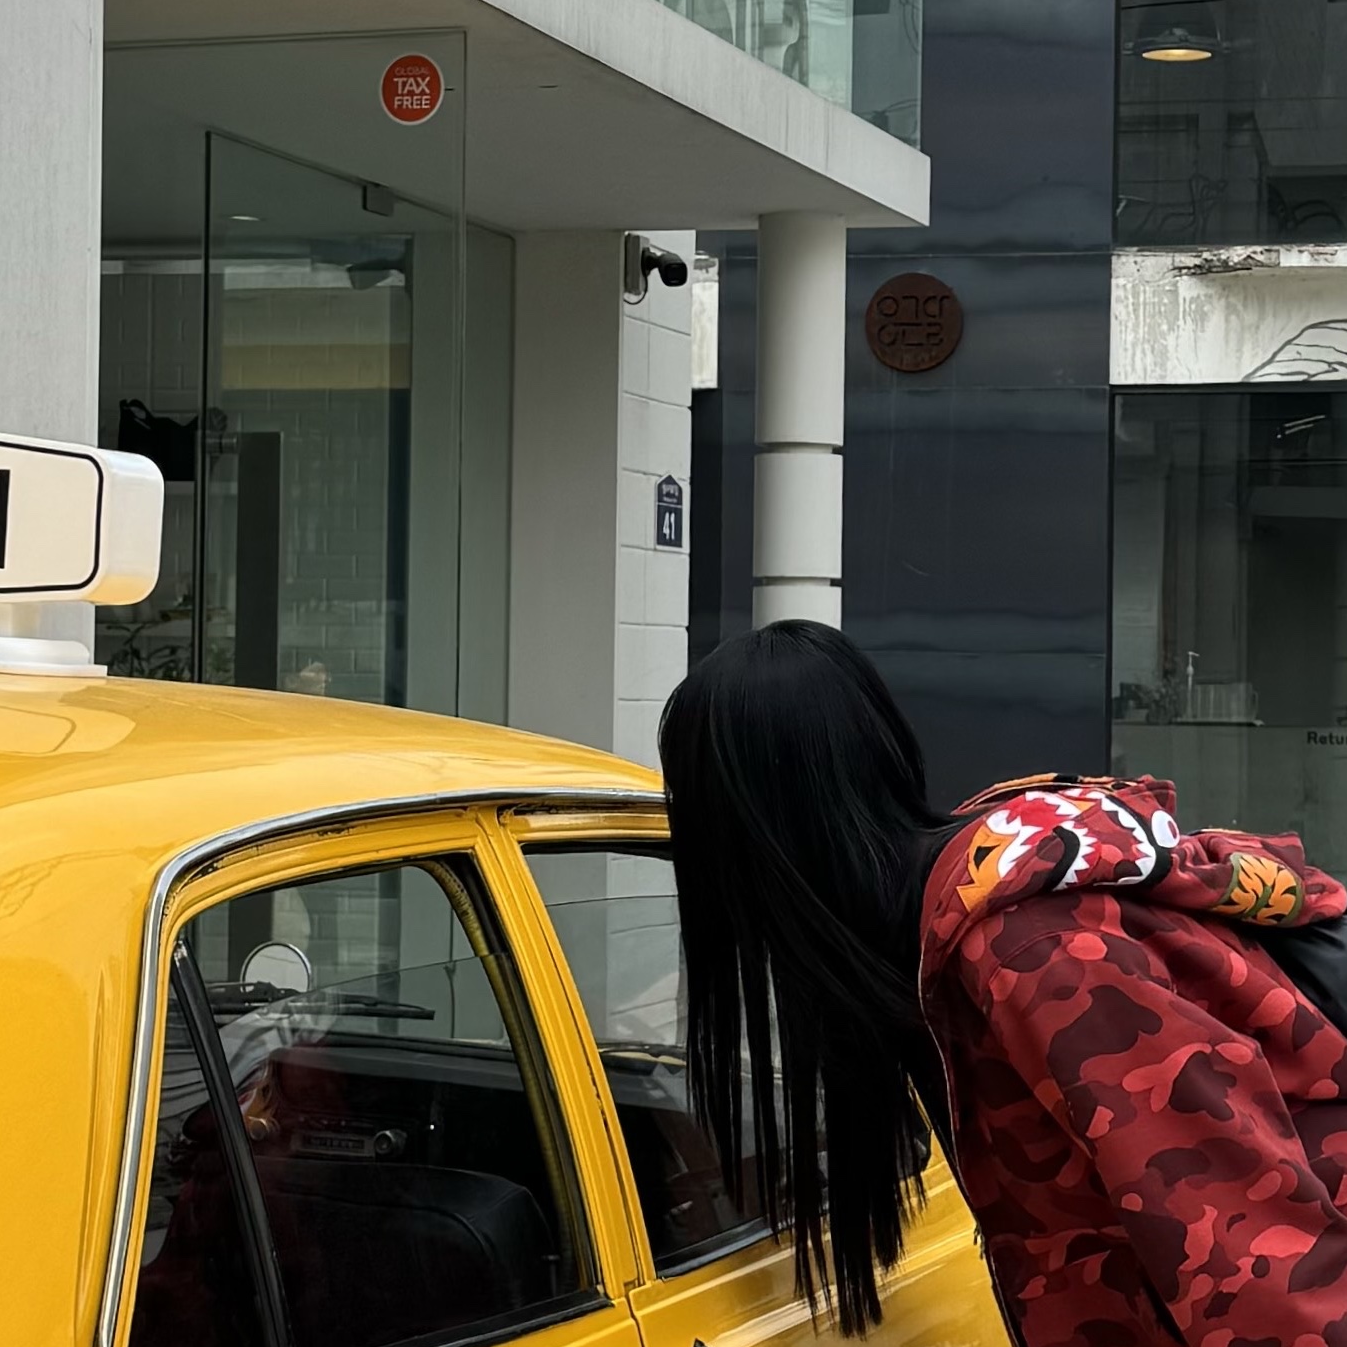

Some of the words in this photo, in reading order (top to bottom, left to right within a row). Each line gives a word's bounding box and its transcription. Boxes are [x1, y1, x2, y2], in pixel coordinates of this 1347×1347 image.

[393, 76, 431, 94] TAX
[394, 95, 431, 109] FREE
[663, 512, 675, 540] 41
